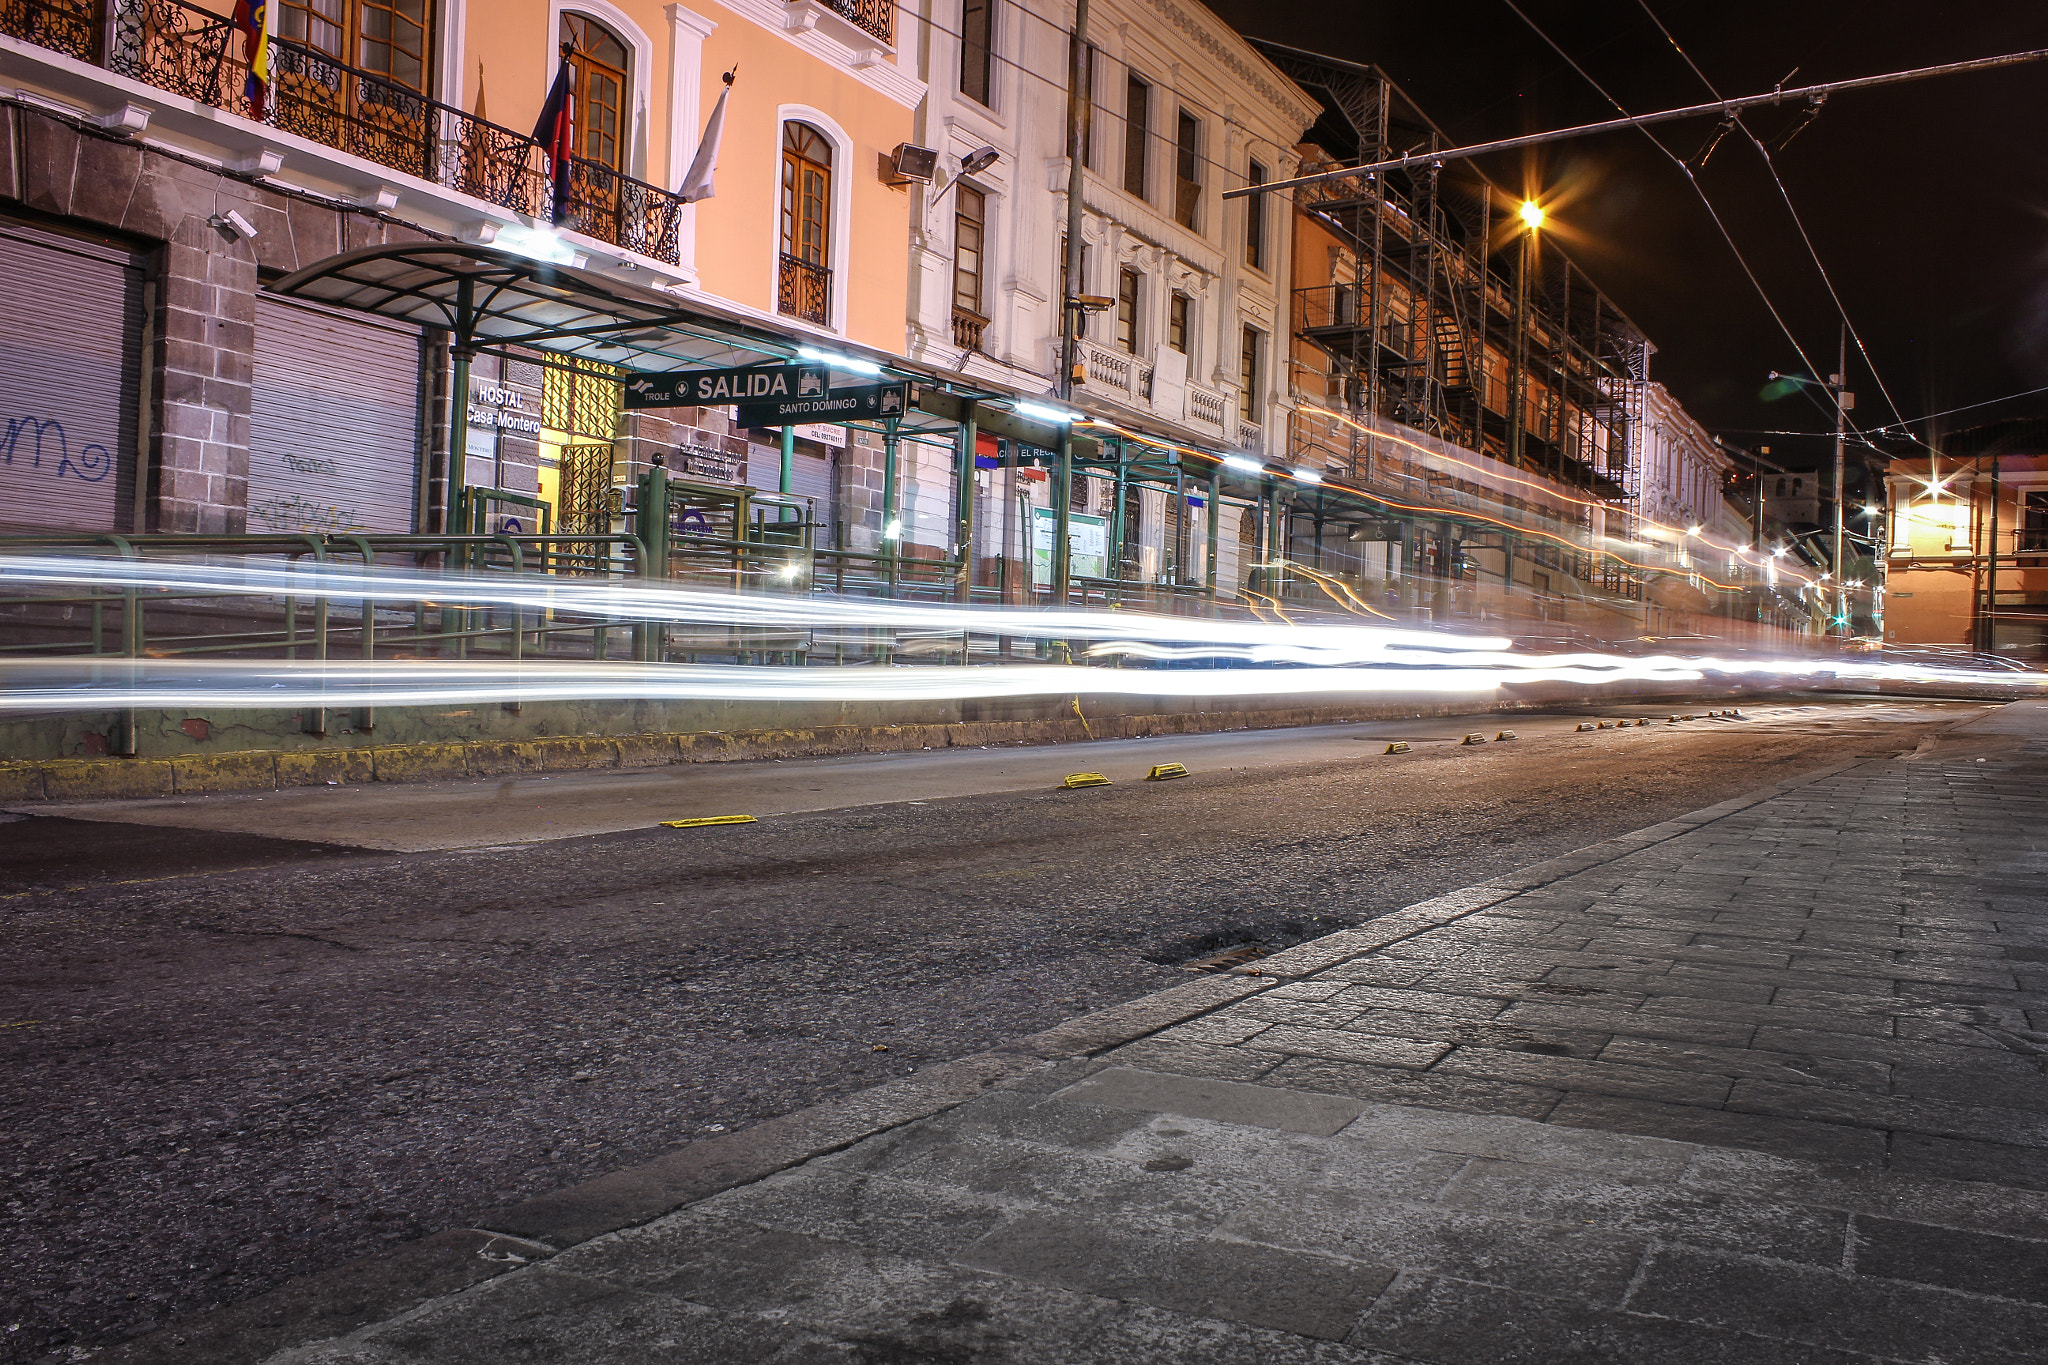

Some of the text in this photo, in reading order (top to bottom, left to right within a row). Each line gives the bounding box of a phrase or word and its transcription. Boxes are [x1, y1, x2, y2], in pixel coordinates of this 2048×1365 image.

[479, 385, 524, 409] HOSTAL
[644, 392, 670, 401] TROLE
[698, 373, 789, 399] SALIDA
[779, 398, 857, 414] SANTO DOMINGO
[467, 405, 540, 434] Casa Montero
